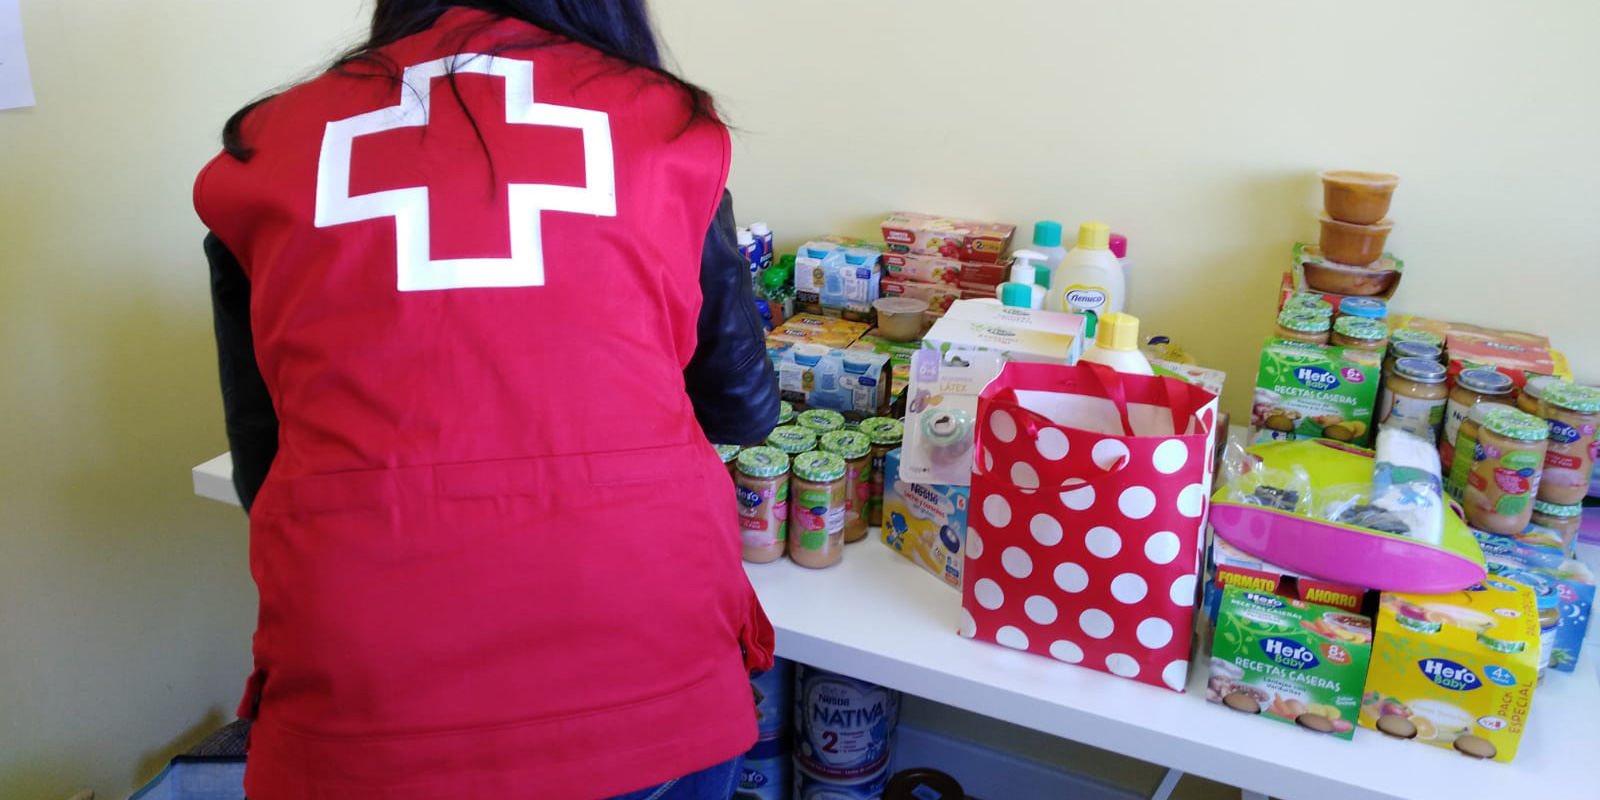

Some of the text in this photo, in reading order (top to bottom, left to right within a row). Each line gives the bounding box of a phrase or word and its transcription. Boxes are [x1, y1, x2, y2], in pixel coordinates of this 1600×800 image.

[1298, 368, 1336, 384] Hero
[1305, 380, 1329, 390] Baby
[1274, 385, 1357, 405] RECETAS CASERAS
[910, 482, 938, 505] Nestlé
[1218, 571, 1276, 592] FORMATO
[1248, 593, 1282, 607] Hero
[1306, 587, 1357, 608] AHORRO
[1266, 639, 1313, 662] Hero
[1328, 644, 1345, 657] 8+
[1274, 655, 1304, 670] Baby
[1425, 660, 1476, 683] Hero
[1235, 657, 1341, 692] RECETAS CASERAS
[1492, 668, 1511, 679] 4+
[813, 702, 884, 728] NATIVA
[1498, 692, 1512, 717] PACK
[1509, 682, 1532, 734] ESPECIAL
[822, 731, 838, 754] 2
